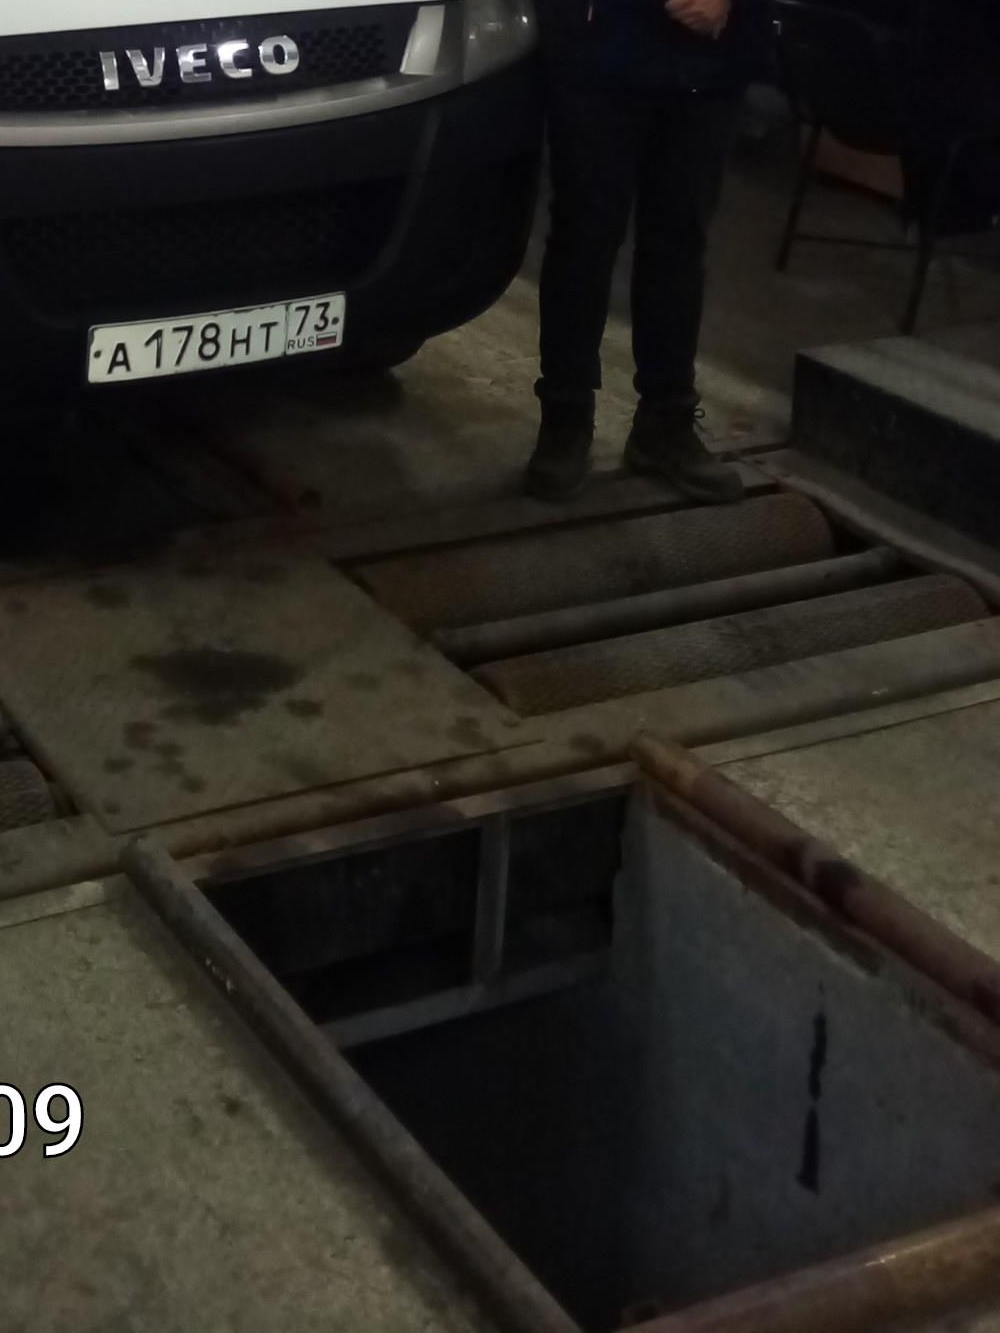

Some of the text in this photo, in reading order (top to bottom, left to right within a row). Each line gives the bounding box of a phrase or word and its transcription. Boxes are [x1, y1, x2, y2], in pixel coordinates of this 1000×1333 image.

[99, 34, 300, 91] IVECO
[294, 302, 331, 335] 73
[287, 336, 315, 350] RUS
